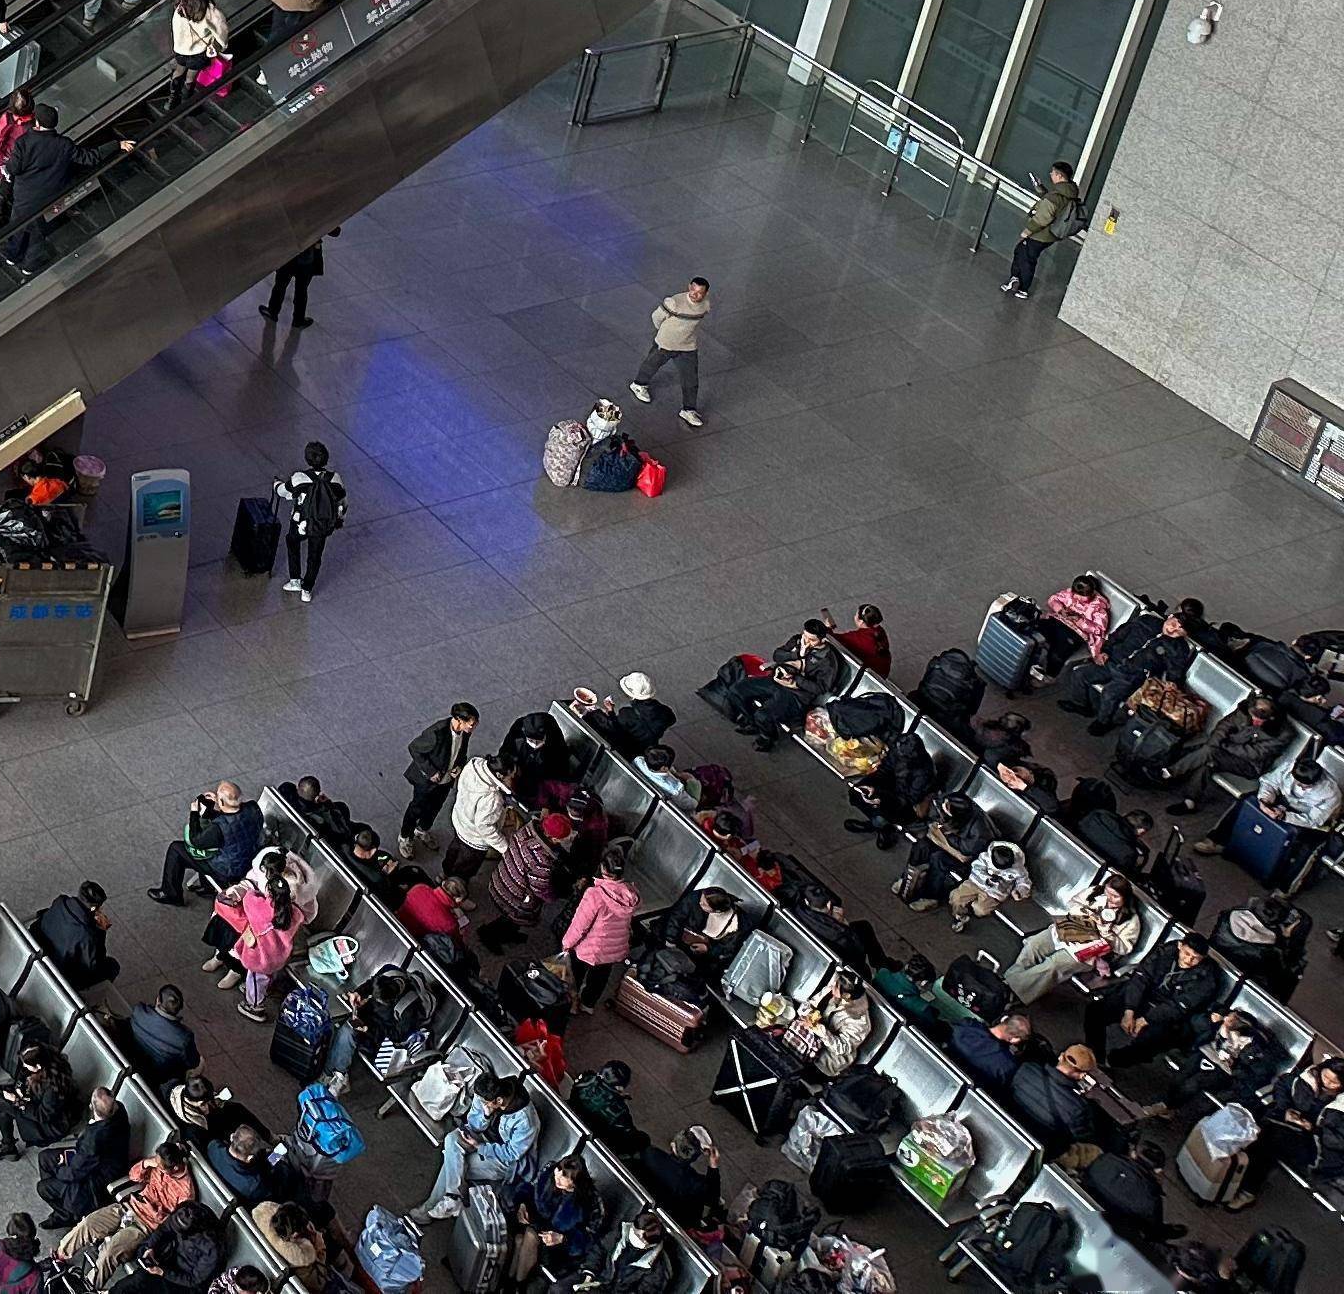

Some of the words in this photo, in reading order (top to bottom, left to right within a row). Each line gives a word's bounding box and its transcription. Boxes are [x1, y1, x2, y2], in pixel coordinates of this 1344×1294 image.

[287, 40, 334, 78] 禁止抛物
[8, 603, 94, 621] 成都东站
